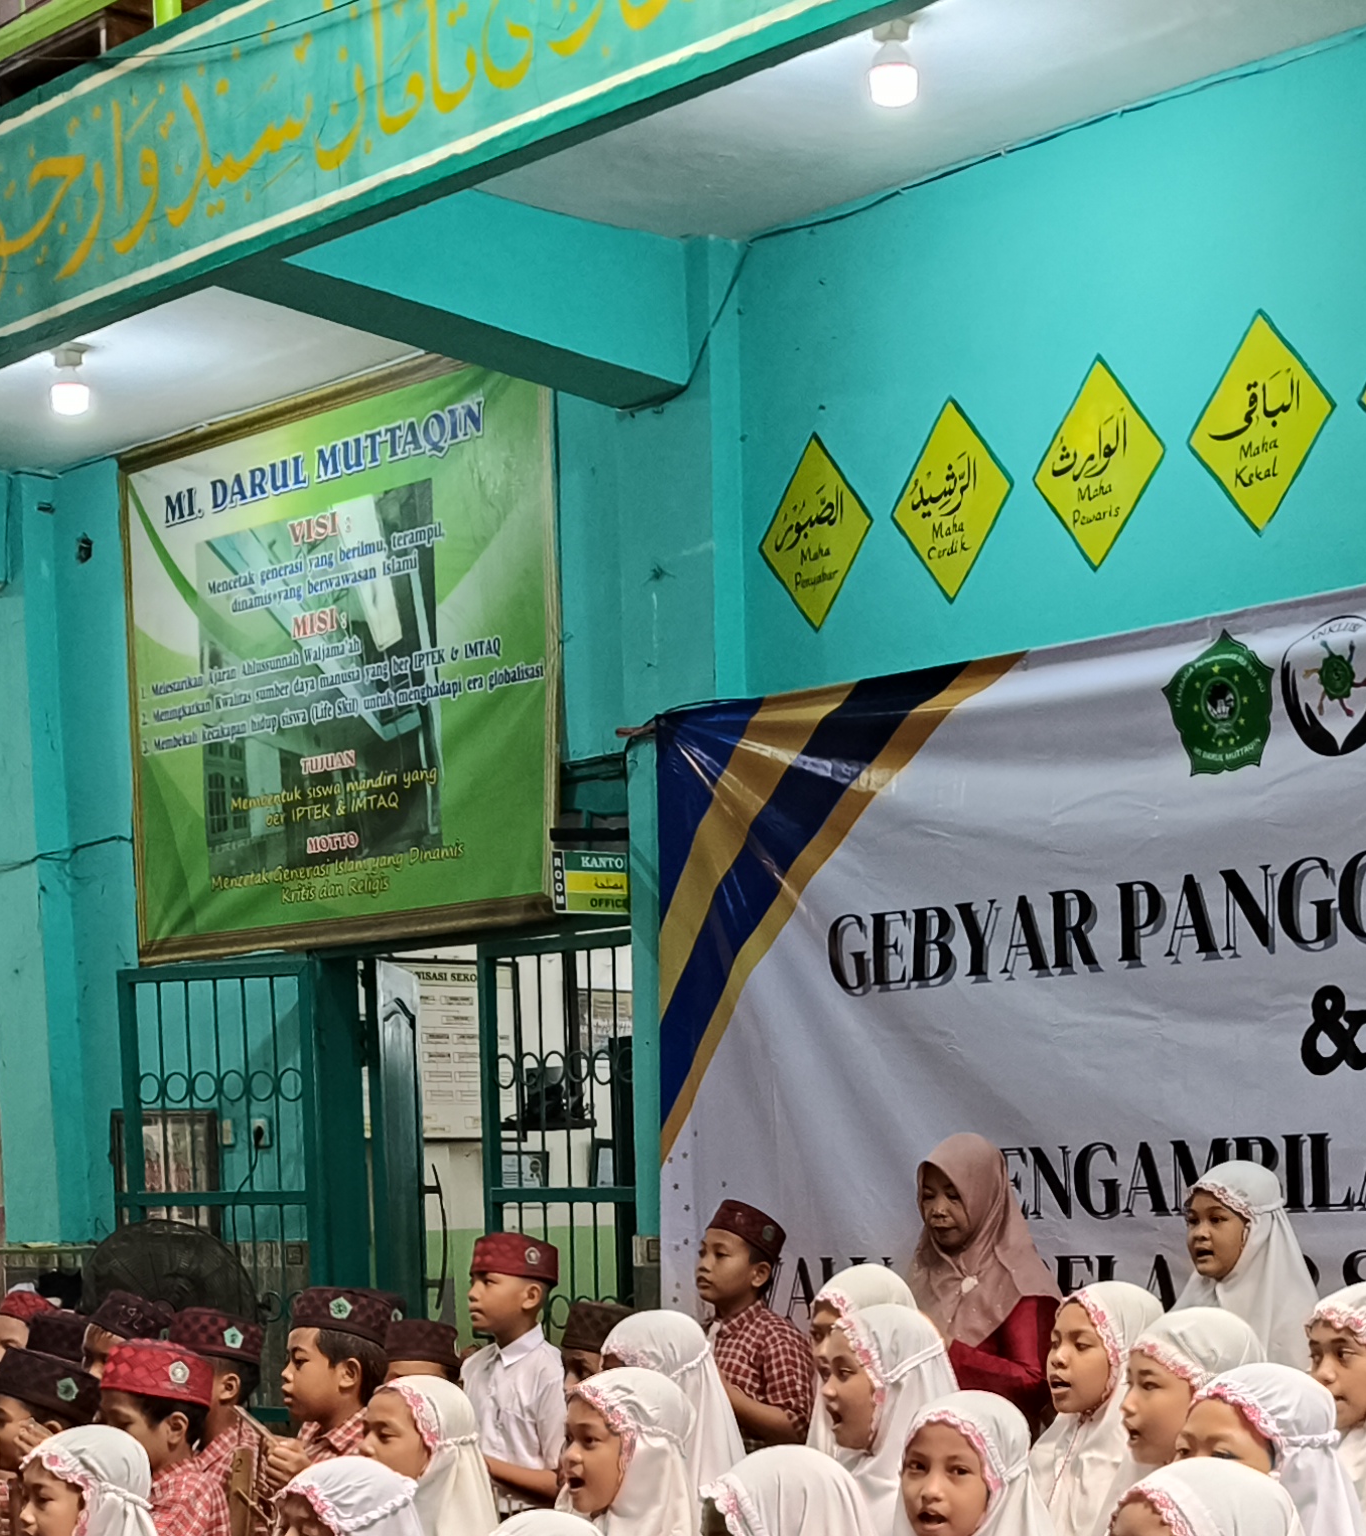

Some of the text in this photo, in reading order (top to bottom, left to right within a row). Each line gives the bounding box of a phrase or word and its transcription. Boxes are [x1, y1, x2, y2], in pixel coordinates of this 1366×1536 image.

[165, 398, 484, 525] MI. DARUL MUTTAQIN
[1238, 436, 1279, 461] Maha
[1234, 455, 1279, 489] Kekal
[1076, 480, 1113, 503] Maha
[288, 511, 340, 545] VISI
[931, 519, 965, 543] Maha
[1071, 504, 1121, 529] Pewaris
[800, 544, 831, 565] Maha
[926, 535, 972, 560] Cerdik
[207, 570, 256, 597] Mencetak
[260, 560, 304, 586] generasi
[308, 553, 334, 576] yang
[339, 540, 387, 565] berilmu,
[276, 584, 302, 607] yang
[307, 566, 377, 595] berwawasan
[382, 550, 418, 578] Islami
[292, 607, 337, 639] MISI
[255, 683, 289, 701] sumber
[293, 677, 316, 697] daya
[320, 668, 360, 689] manusia
[365, 663, 388, 683] yang
[391, 656, 410, 675] ber
[412, 649, 445, 670] IPTEK
[464, 637, 501, 659] IMTAQ
[250, 714, 278, 734] hidup
[281, 710, 307, 728] siswa
[363, 693, 394, 711] untuk
[398, 678, 463, 705] menghadapi
[467, 677, 484, 691] era
[488, 662, 544, 691] globalisasi
[300, 750, 356, 774] TUJUAN
[230, 767, 438, 811] Membentuk siswa mandiri yang
[291, 803, 331, 824] IPTEK
[336, 801, 347, 817] &
[350, 791, 399, 813] IMTAQ
[307, 831, 359, 853] MOTTO
[211, 840, 465, 892] Mencetak Generasi Islam yang Dinamis
[581, 856, 623, 869] KANTO
[281, 882, 315, 904] Kritis
[319, 878, 344, 897] dan
[554, 857, 565, 904] ROOM
[590, 897, 623, 908] OFFIC
[827, 888, 1102, 995] GEBYAR
[415, 970, 477, 983] NISASI SEKO
